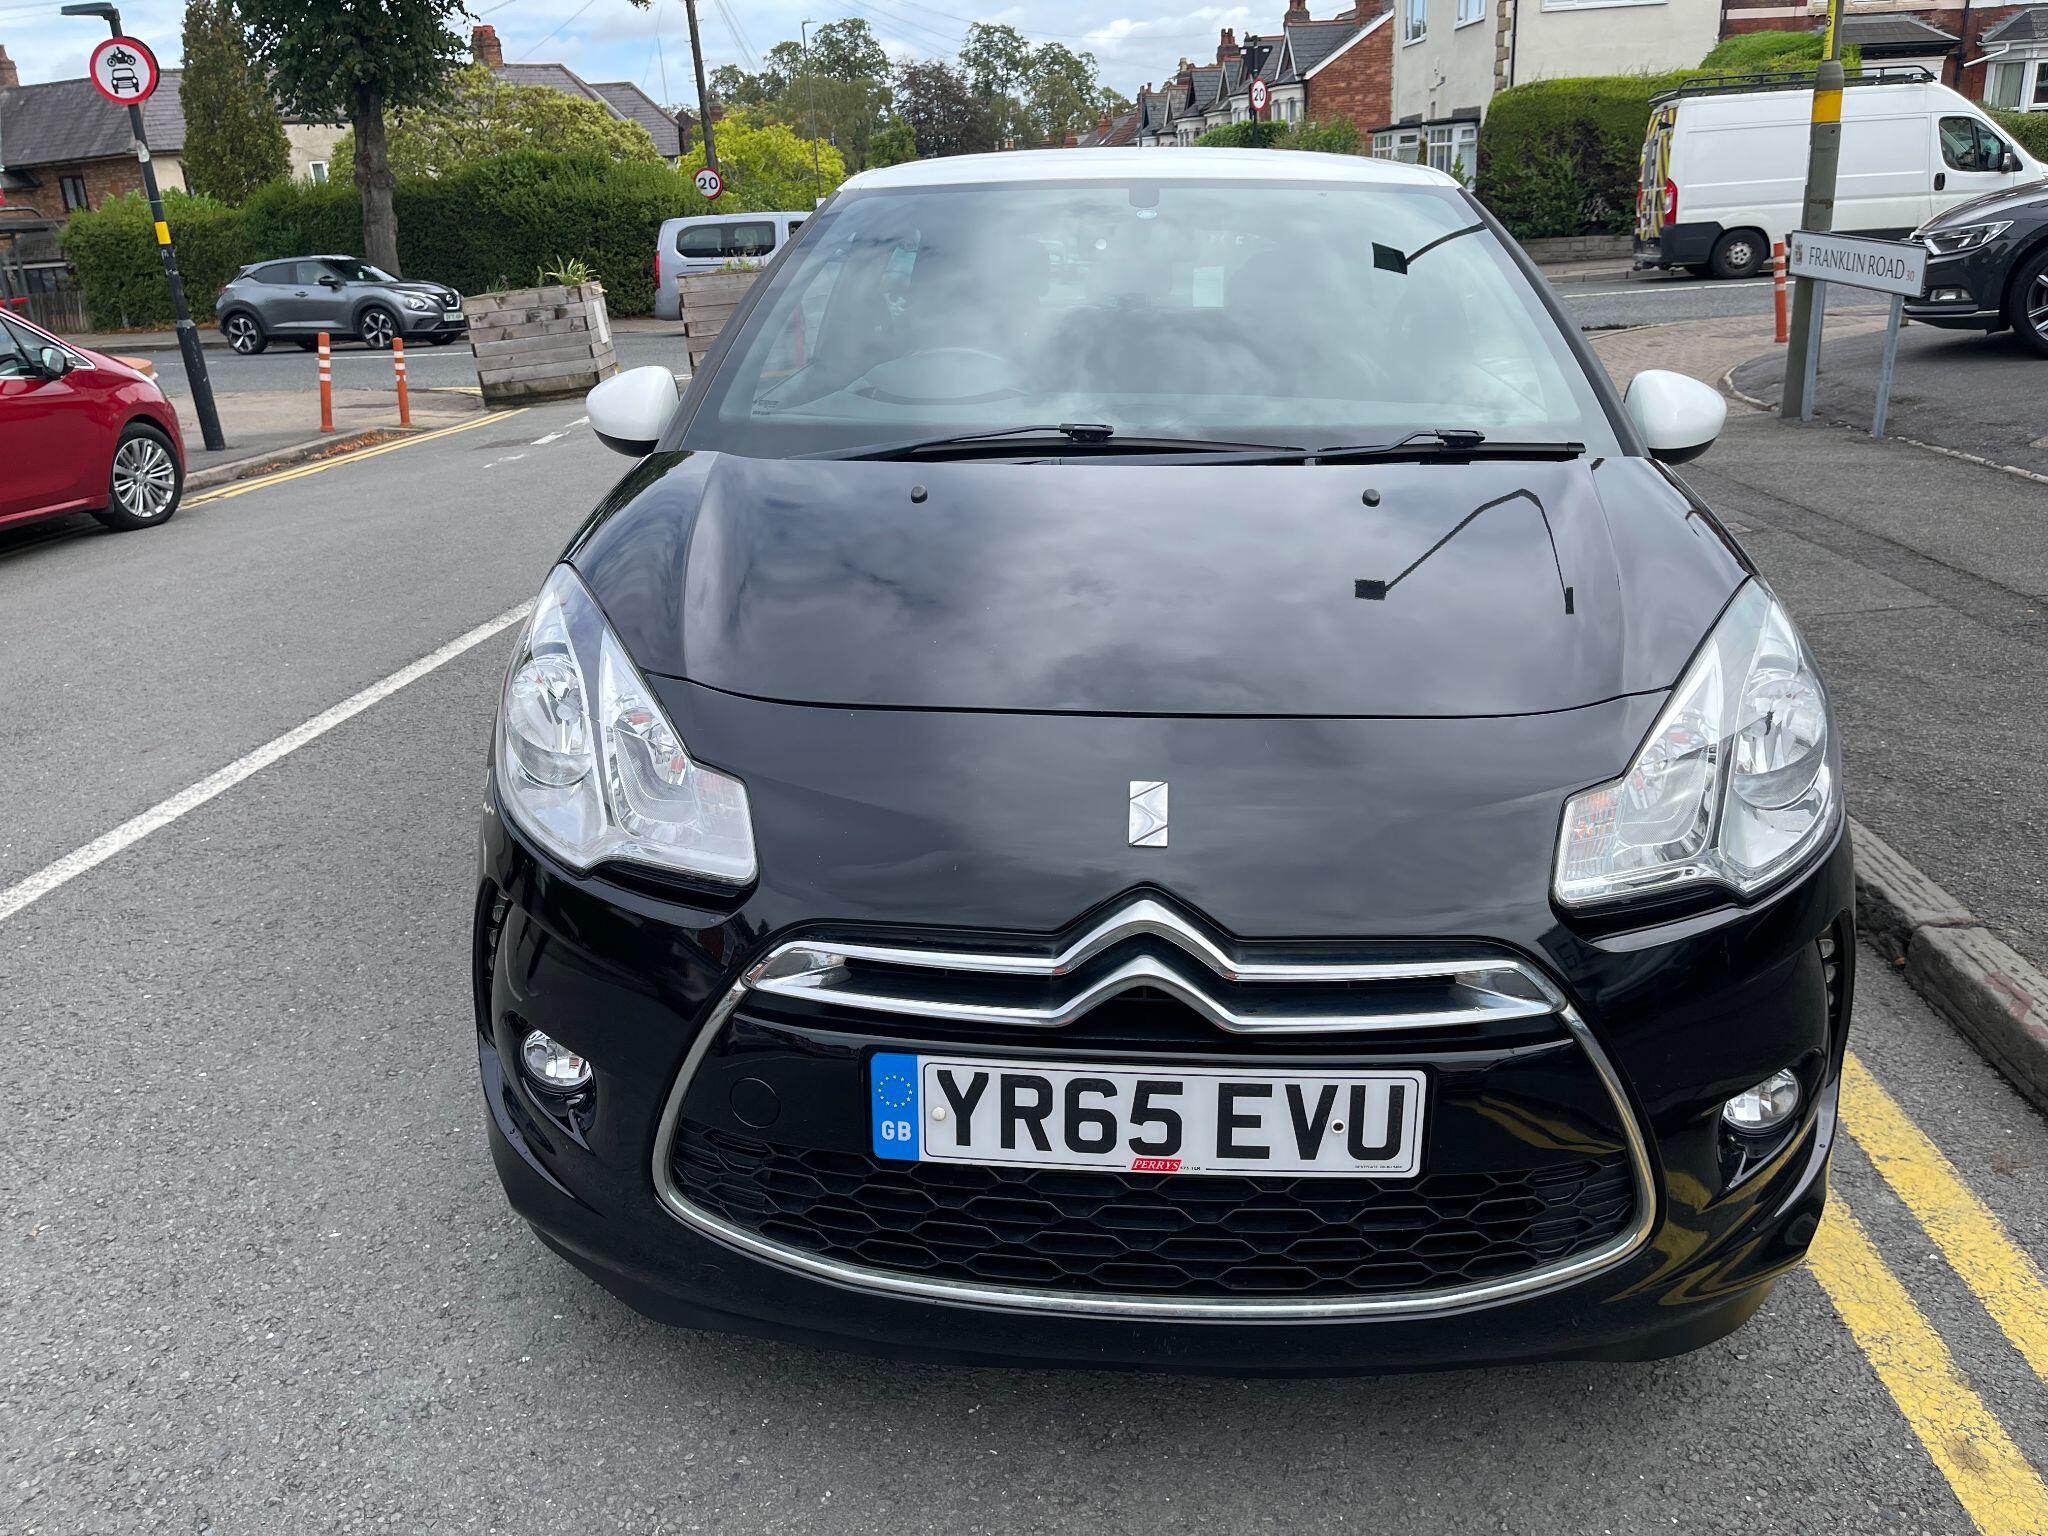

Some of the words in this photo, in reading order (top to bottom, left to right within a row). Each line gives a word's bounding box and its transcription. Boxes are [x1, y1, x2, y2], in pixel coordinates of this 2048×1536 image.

[1254, 88, 1265, 101] 20
[698, 177, 718, 190] 20
[1808, 246, 1867, 273] FRANKLIN
[1867, 255, 1905, 280] ROAD
[1905, 270, 1915, 282] 30
[936, 1069, 1184, 1157] YR65
[1215, 1082, 1406, 1161] EVU
[881, 1119, 912, 1142] GB
[1133, 1159, 1180, 1171] PERRYS
